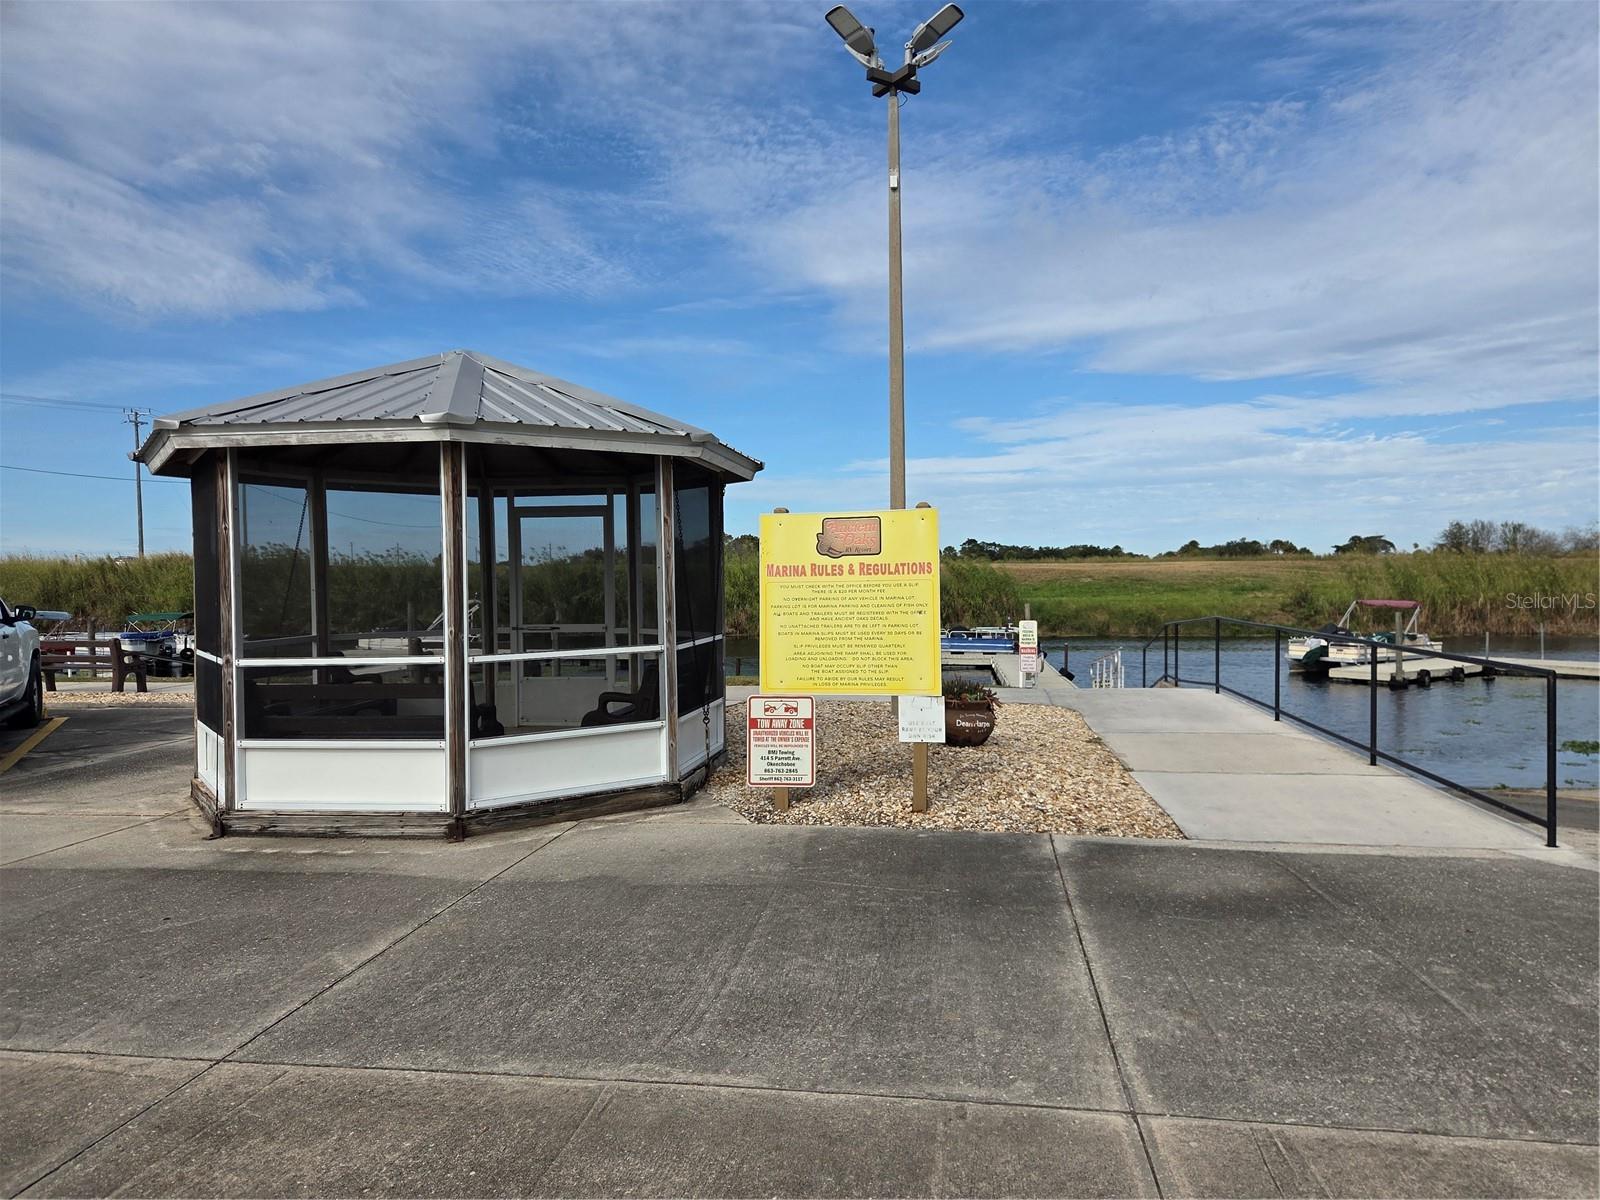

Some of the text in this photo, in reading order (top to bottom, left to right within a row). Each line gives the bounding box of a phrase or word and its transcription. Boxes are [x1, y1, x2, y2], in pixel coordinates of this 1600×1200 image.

[848, 564, 854, 576] &
[757, 718, 804, 728] TOW AWAY ZONE
